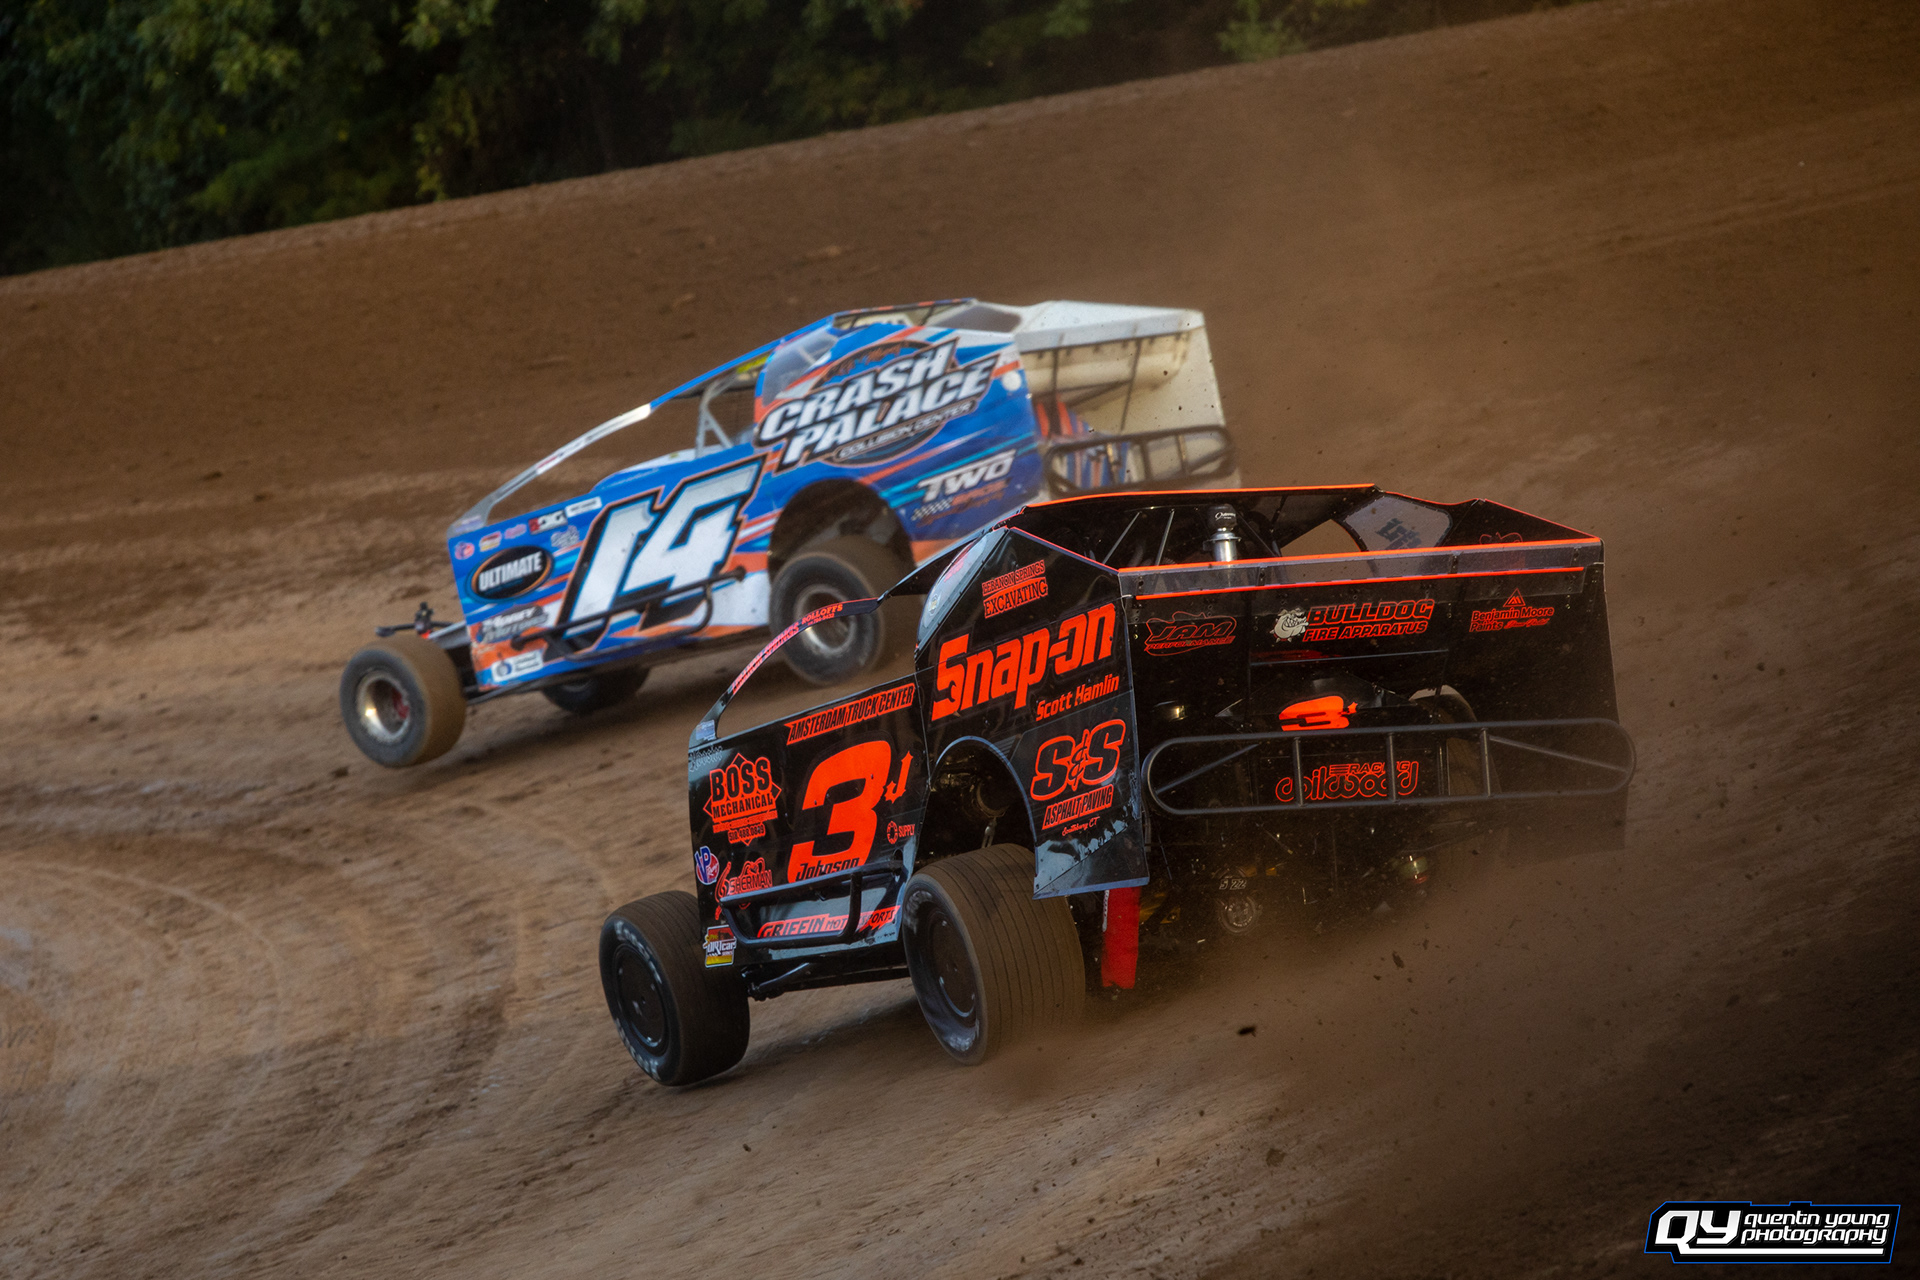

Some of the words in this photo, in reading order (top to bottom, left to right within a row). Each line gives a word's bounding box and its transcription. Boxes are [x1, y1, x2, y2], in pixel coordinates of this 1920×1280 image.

[760, 340, 955, 442] CRASH
[782, 357, 996, 465] PALACE
[914, 400, 975, 429] CENTER
[918, 449, 1016, 503] TWO
[558, 455, 767, 640] 14
[479, 551, 543, 592] ULTIMATE
[982, 570, 1014, 595] LEBANON
[1014, 560, 1046, 582] SPRINGS
[801, 602, 844, 625] ROLLOFFS
[984, 578, 1048, 617] EXCAVATING
[1307, 599, 1435, 627] BULLDOG
[1472, 608, 1520, 622] Benjamin
[1521, 606, 1555, 618] Moore
[1148, 621, 1233, 642] JAM
[1302, 626, 1340, 642] FIRE
[1338, 621, 1429, 640] APPARATUS
[1469, 621, 1504, 632] Paints
[931, 602, 1117, 722] Snap-on
[788, 706, 847, 742] AMSTERDAM
[846, 695, 880, 723] TRUCK
[878, 685, 915, 713] CENTER
[1036, 691, 1073, 721] Scott
[1074, 673, 1120, 706] Hamlin
[1279, 695, 1350, 732] 3
[1030, 718, 1126, 801] S&S
[710, 757, 771, 802] BOSS
[713, 793, 774, 820] MECHANICAL
[788, 740, 892, 885] 3
[1043, 798, 1080, 828] ASPHALT
[1079, 785, 1114, 815] PAVING
[694, 846, 712, 884] VP
[729, 870, 773, 894] SHERMAN
[795, 857, 861, 882] Johnson
[760, 916, 826, 938] GRIFFIN
[824, 908, 898, 932] MOTSPORTS
